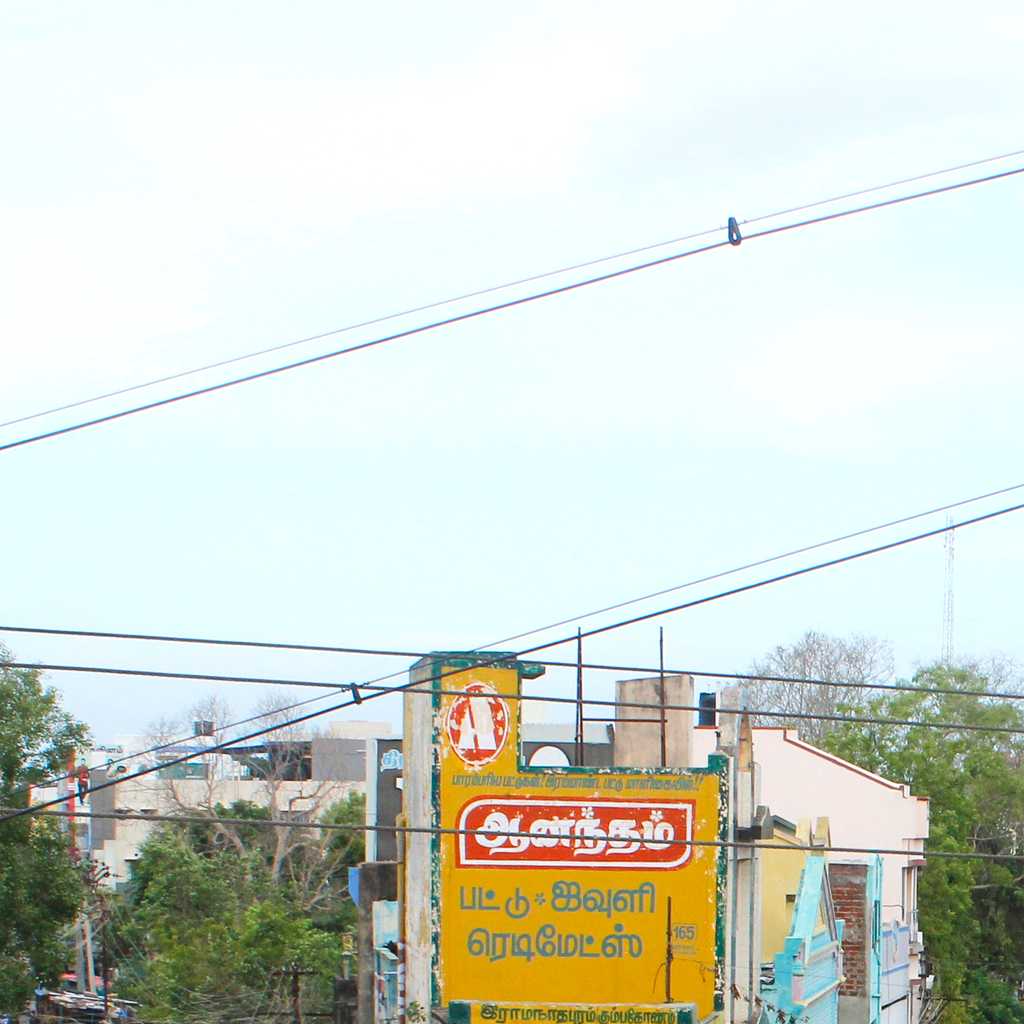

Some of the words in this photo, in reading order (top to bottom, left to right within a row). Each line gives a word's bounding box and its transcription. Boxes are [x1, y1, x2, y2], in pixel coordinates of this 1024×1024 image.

[474, 806, 676, 856] ஆனந்தம்
[550, 880, 657, 919] ஜவுளி
[467, 923, 644, 962] ரெடிமேட்ஸ்
[480, 1004, 596, 1024] இராமநாதபுரம்
